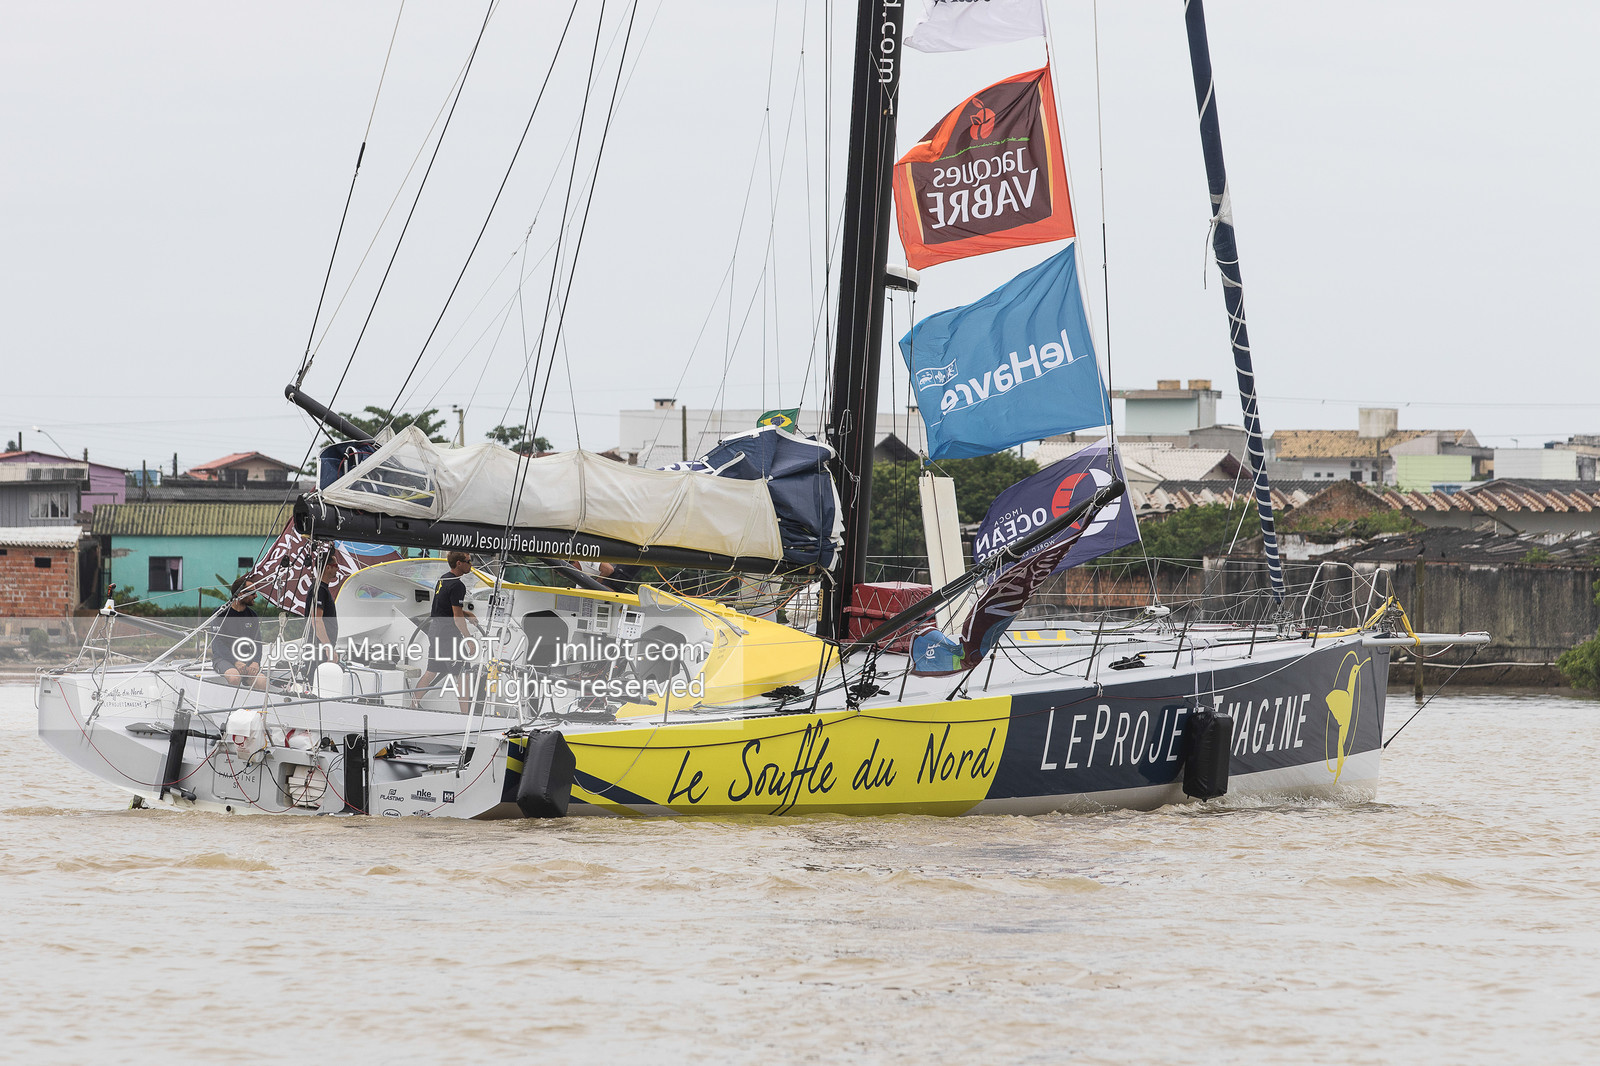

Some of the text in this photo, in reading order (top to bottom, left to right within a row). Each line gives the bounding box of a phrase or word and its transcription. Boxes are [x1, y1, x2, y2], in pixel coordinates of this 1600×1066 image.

[442, 531, 601, 558] www.lesouffledunord.com
[667, 718, 997, 815] Le Souffle du Nord
[416, 788, 432, 798] nke
